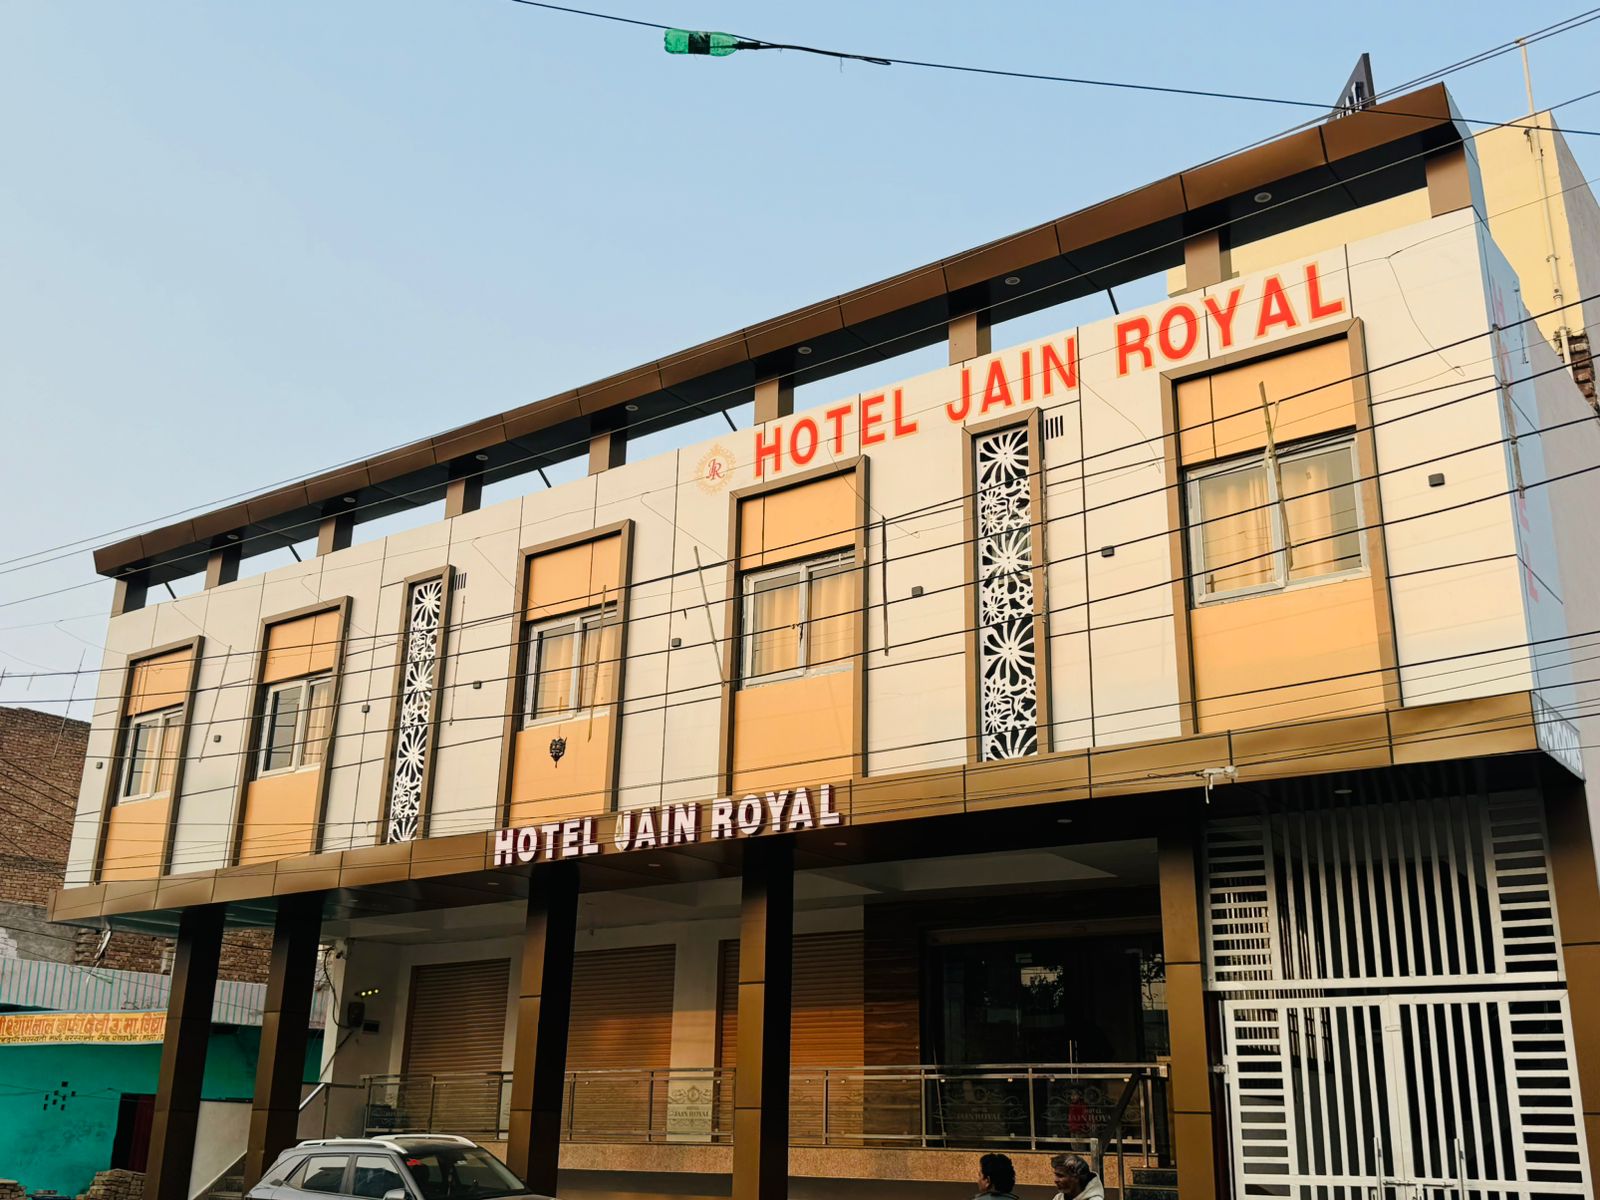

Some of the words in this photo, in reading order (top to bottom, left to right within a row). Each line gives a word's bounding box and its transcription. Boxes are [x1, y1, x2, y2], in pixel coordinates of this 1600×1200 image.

[753, 388, 919, 477] HOTEL
[945, 335, 1079, 423] JAIN
[1114, 262, 1345, 378] ROYAL
[494, 816, 602, 866] HOTEL
[614, 802, 701, 852] JAIN
[710, 784, 842, 839] ROYAL
